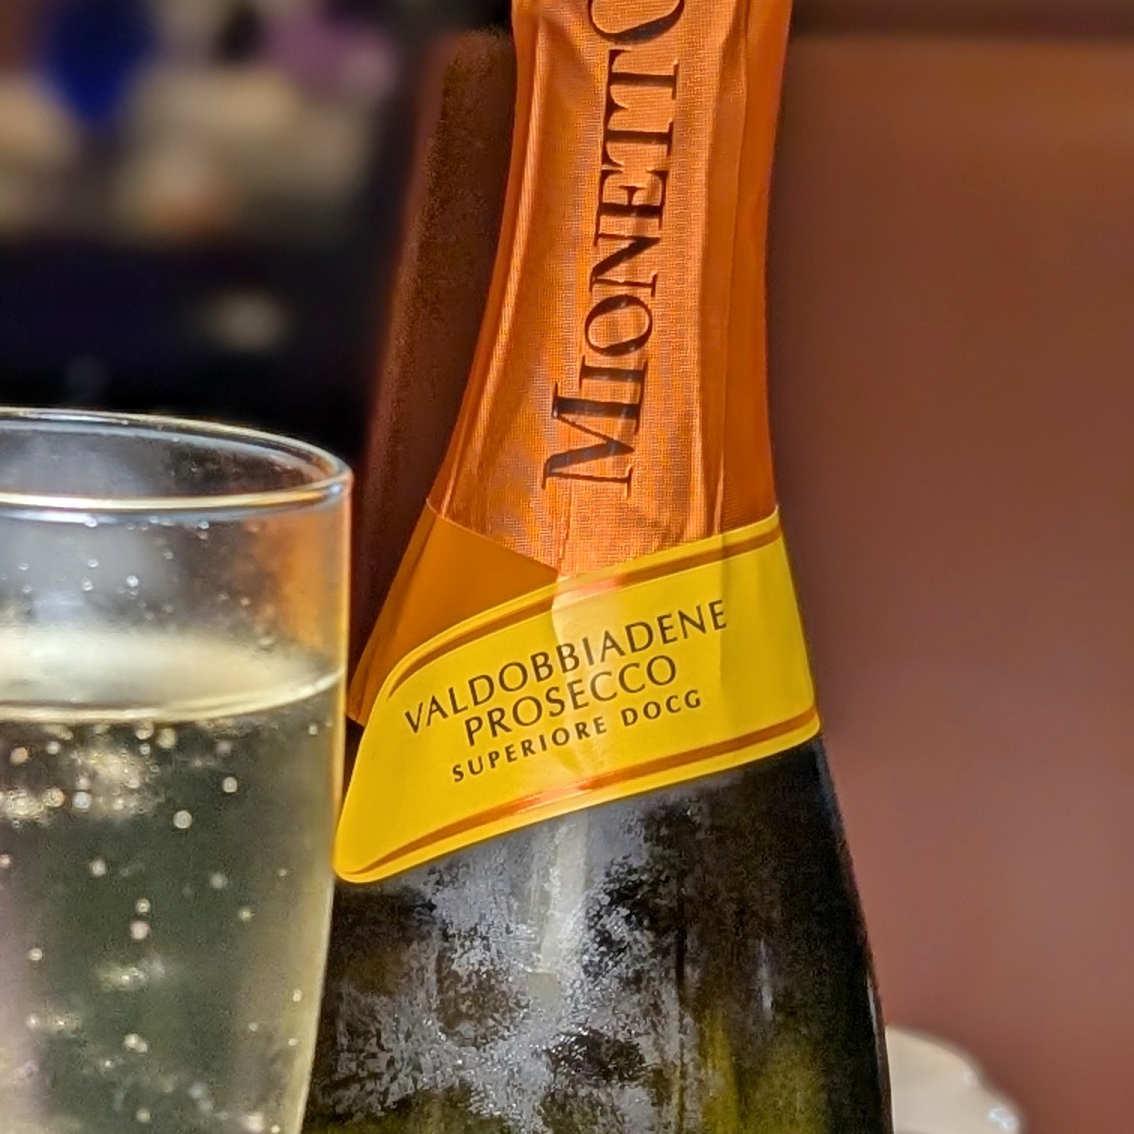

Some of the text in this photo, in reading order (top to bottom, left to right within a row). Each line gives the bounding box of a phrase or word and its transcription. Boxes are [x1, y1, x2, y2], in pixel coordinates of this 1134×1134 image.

[542, 0, 684, 497] MIONETTO
[404, 599, 727, 734] VALDOBBIADENE
[464, 654, 677, 747] PROSECCO
[451, 689, 701, 783] SUPERIORE DOCG
